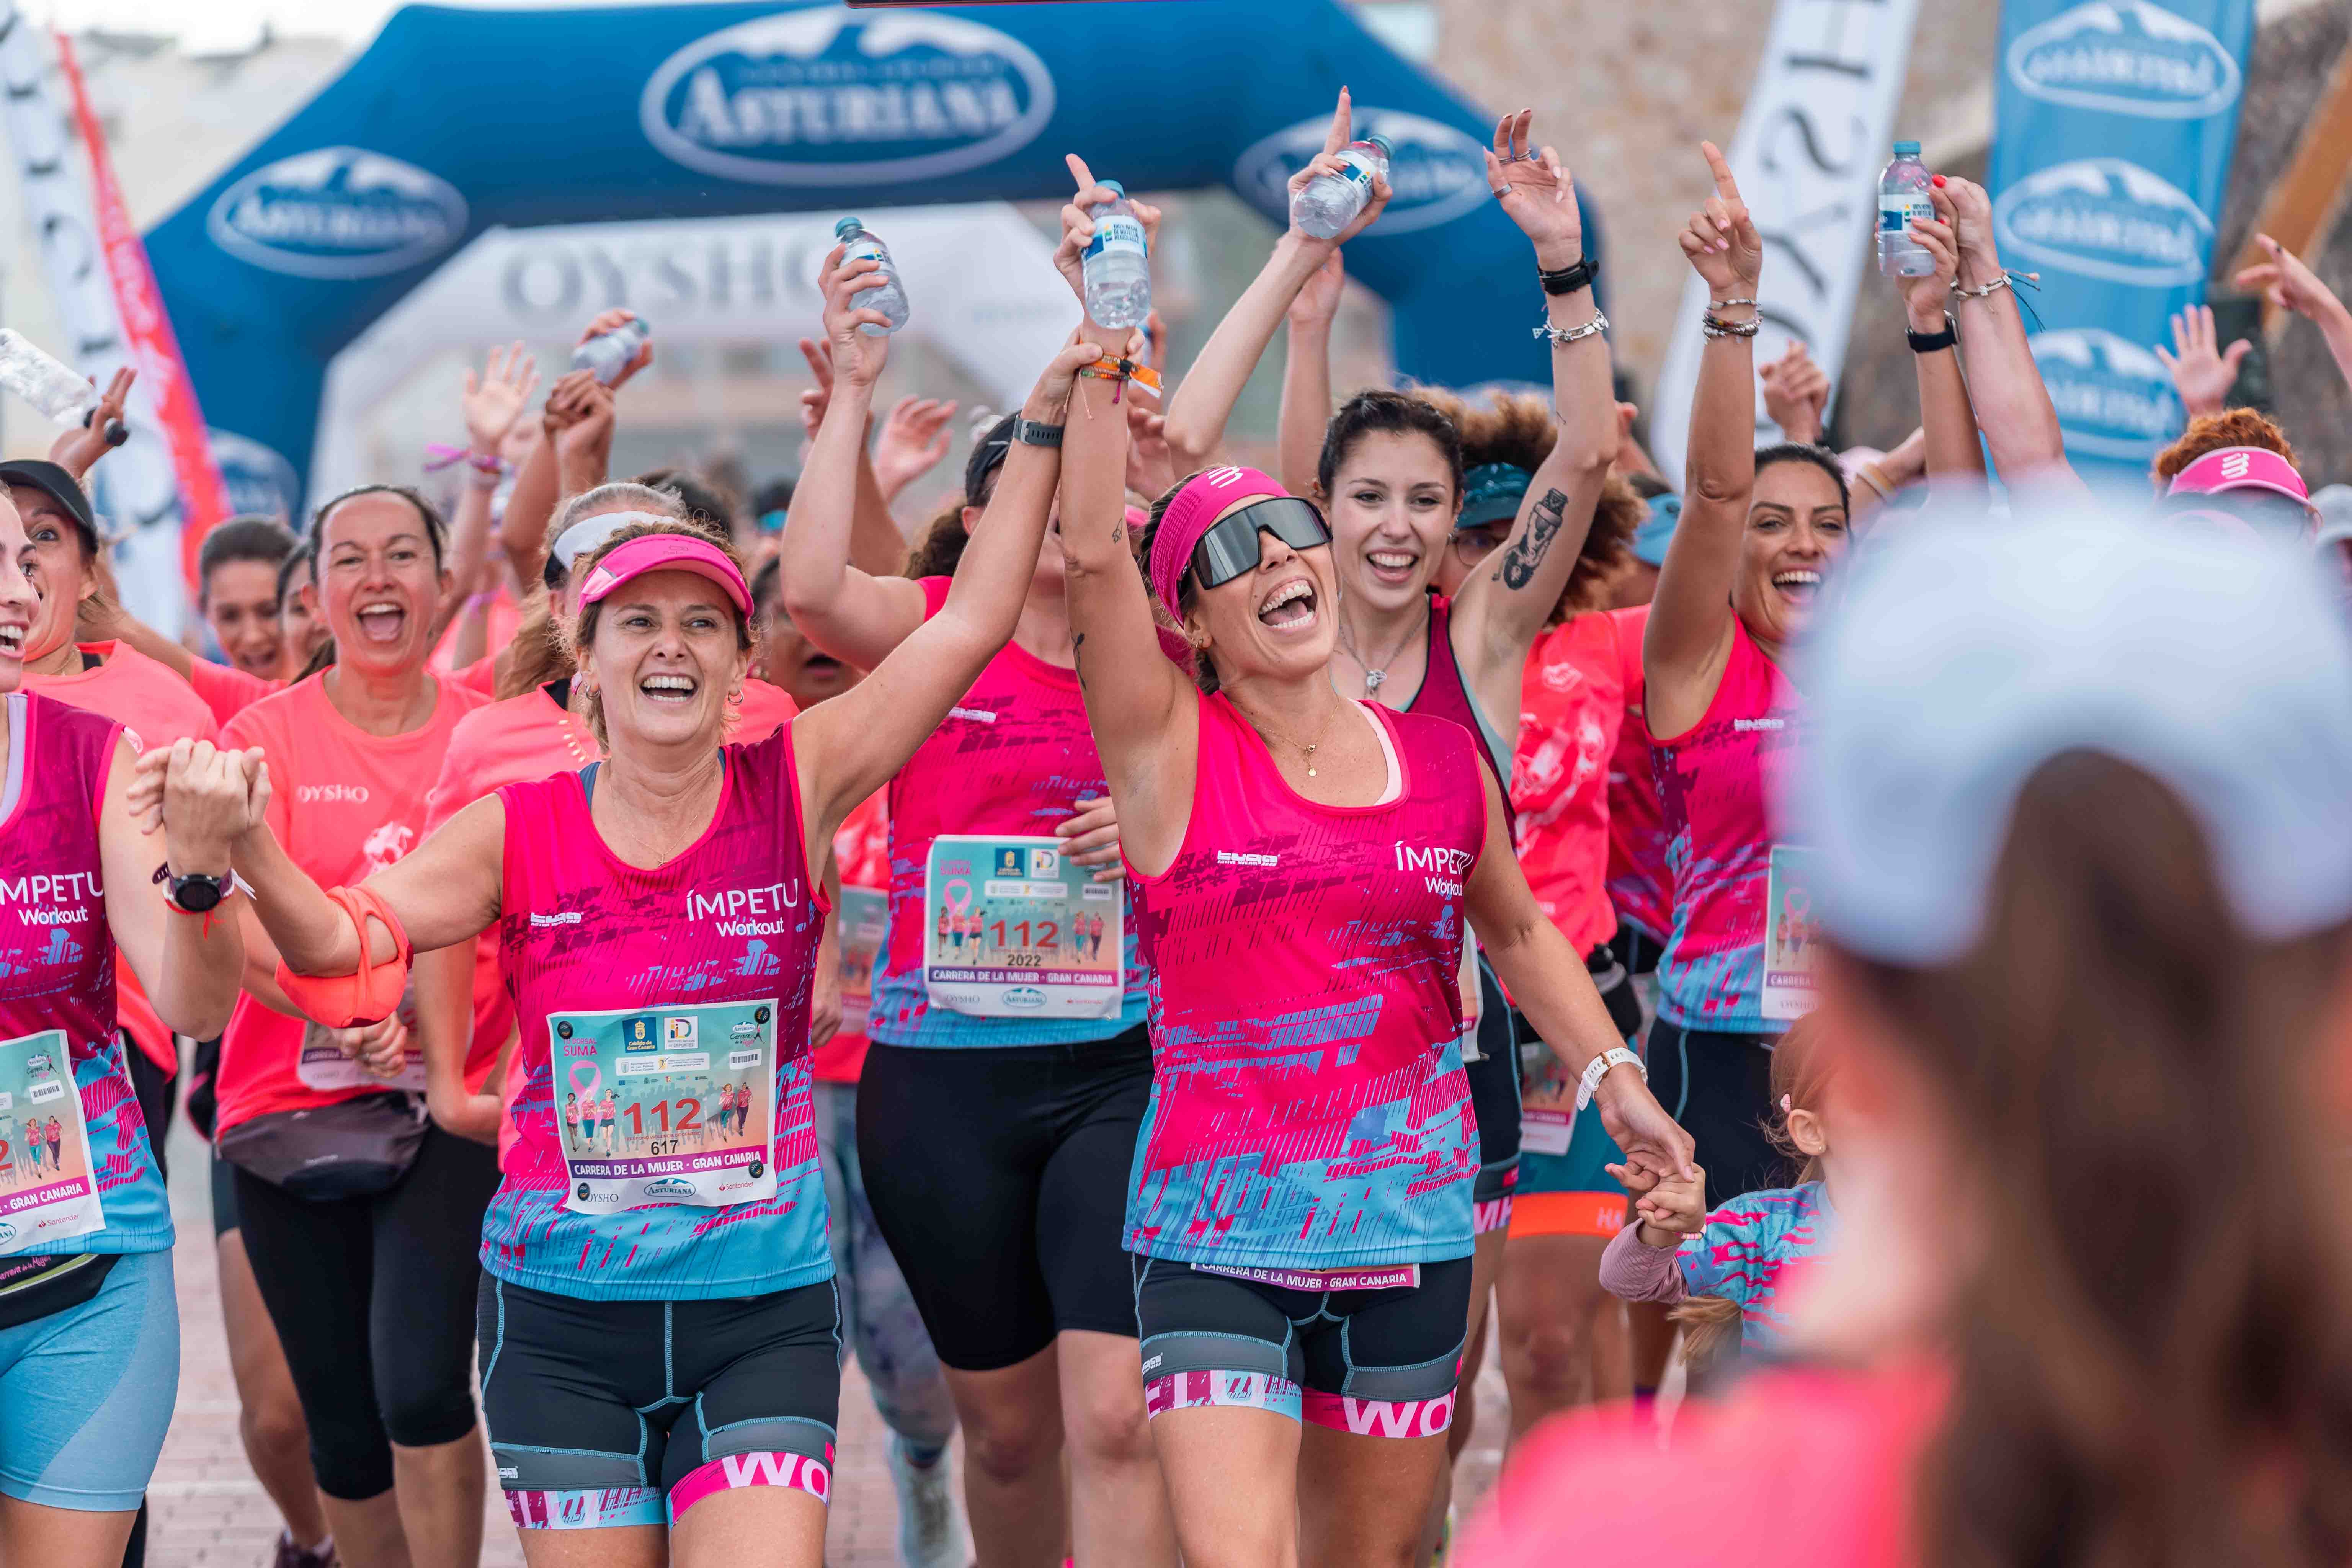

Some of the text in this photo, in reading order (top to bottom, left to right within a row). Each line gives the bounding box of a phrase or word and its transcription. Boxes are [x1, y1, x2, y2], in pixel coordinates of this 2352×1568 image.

[675, 65, 1021, 147] ASTURIANA
[940, 866, 971, 876] SUMA
[686, 878, 798, 921] ÍMPETU
[18, 905, 89, 926] Workout
[715, 918, 784, 938] Workout
[989, 920, 1059, 948] 112
[1007, 954, 1042, 967] 2022
[933, 970, 1114, 985] CARRERA DE LA MUJER GRAN CANARIA
[563, 1045, 598, 1057] SUMA
[624, 1098, 702, 1135] 112
[0, 1139, 13, 1171] 2
[651, 1139, 678, 1155] 617
[574, 1150, 762, 1177] CARRERA DE LA MUJER GRAN CANARIA
[648, 1185, 692, 1195] ASTURIANA
[726, 1181, 754, 1189] Santander
[10, 1182, 83, 1210] GRAN CANARIA
[47, 1214, 79, 1227] Santander
[1202, 1263, 1407, 1289] CARRERA DE LA MUJER GRAN CANARIA
